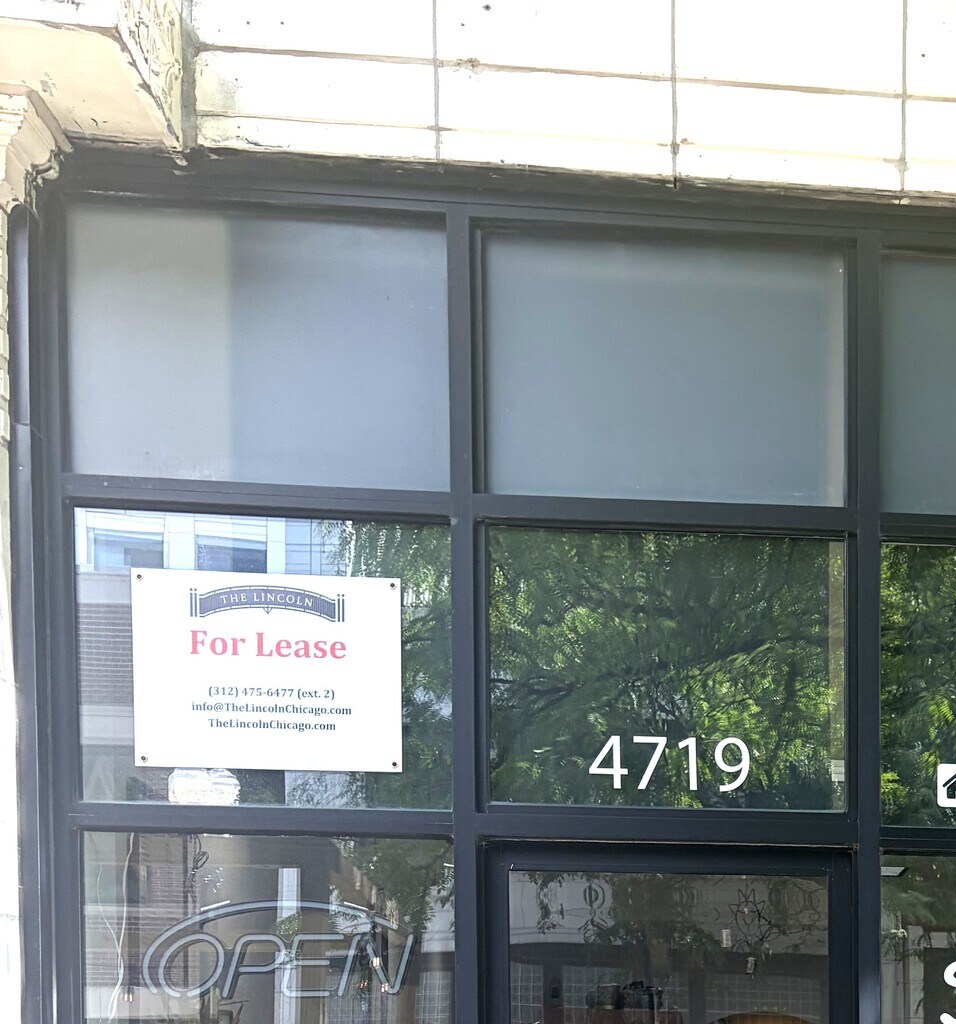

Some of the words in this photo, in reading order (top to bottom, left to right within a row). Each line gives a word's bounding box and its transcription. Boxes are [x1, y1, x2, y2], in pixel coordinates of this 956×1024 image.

[220, 593, 247, 605] THE
[253, 593, 314, 607] LINCOLN
[190, 630, 246, 656] For
[256, 632, 346, 660] Lease
[208, 686, 239, 698] (312)
[241, 687, 294, 699] 475-6477
[297, 688, 321, 701] (ext.
[191, 702, 352, 716] info@TheLincolnChicago.com
[208, 718, 336, 733] TheLincolnChicago.com
[588, 735, 751, 793] 4719
[158, 931, 418, 999] OPEN
